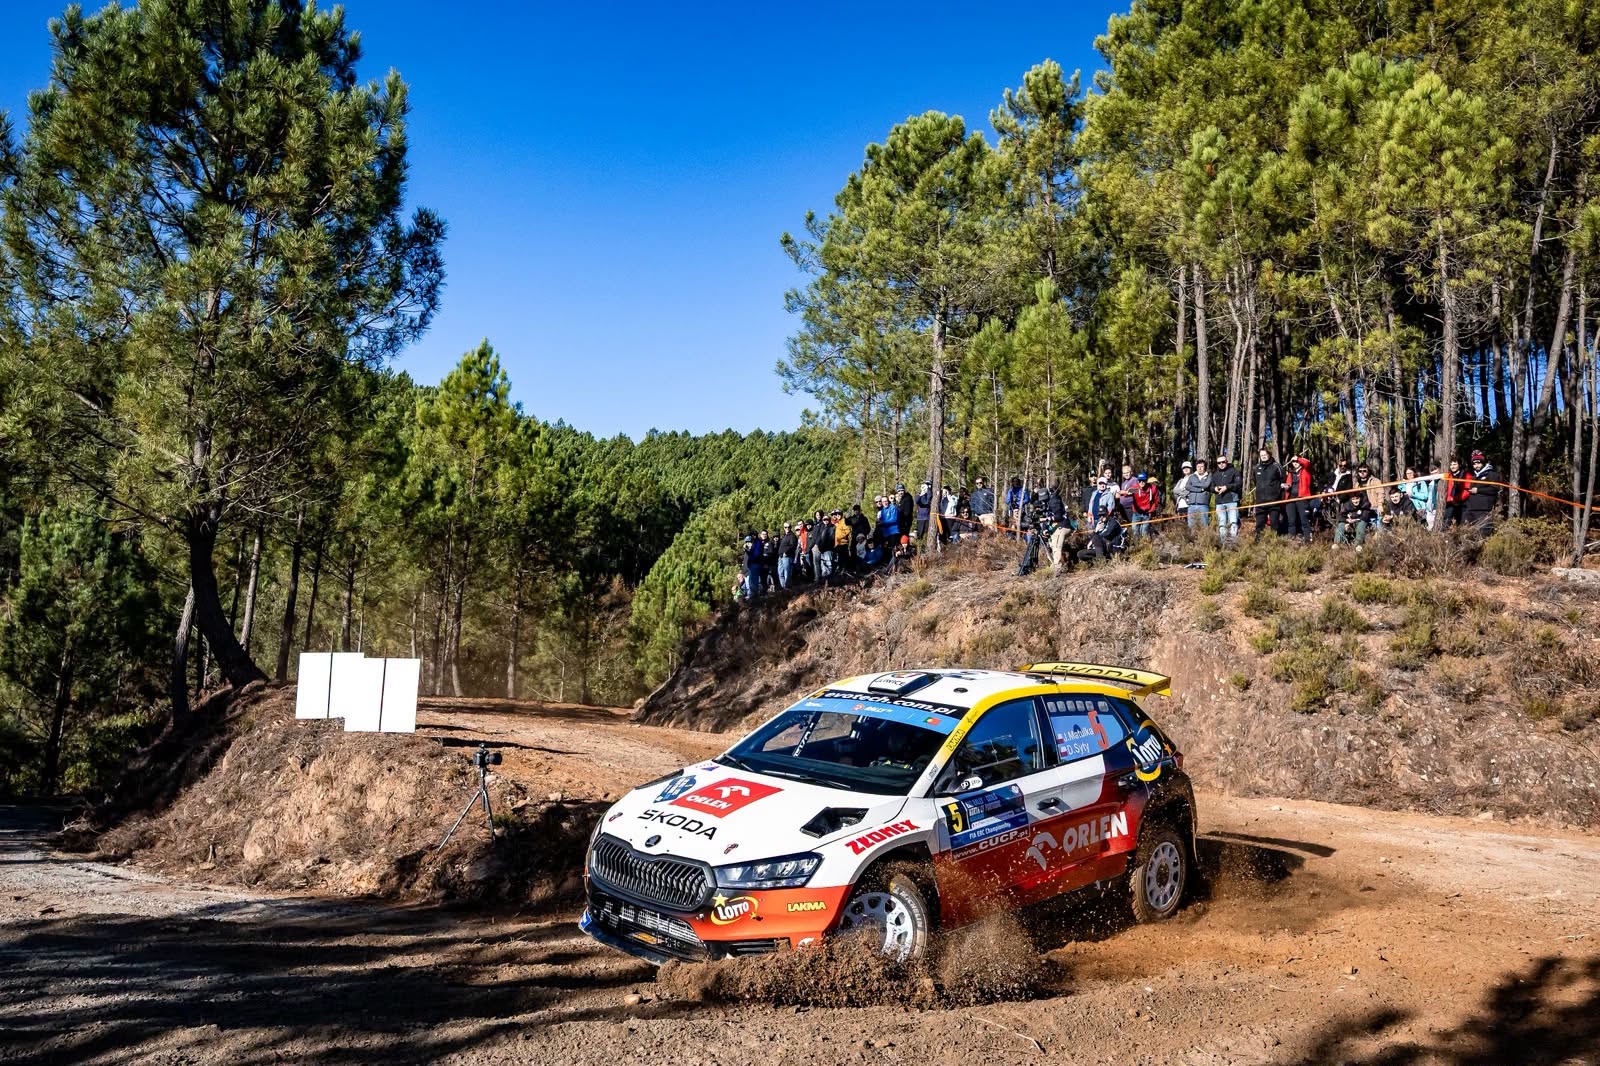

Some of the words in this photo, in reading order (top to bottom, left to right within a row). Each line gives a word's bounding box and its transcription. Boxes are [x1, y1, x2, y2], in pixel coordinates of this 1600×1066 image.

[824, 691, 957, 715] evotech.com.pl
[1087, 710, 1110, 751] 5
[686, 795, 733, 810] ORLEN
[947, 803, 963, 833] 5
[1063, 811, 1129, 853] ORLEN
[787, 901, 827, 913] LAKMA
